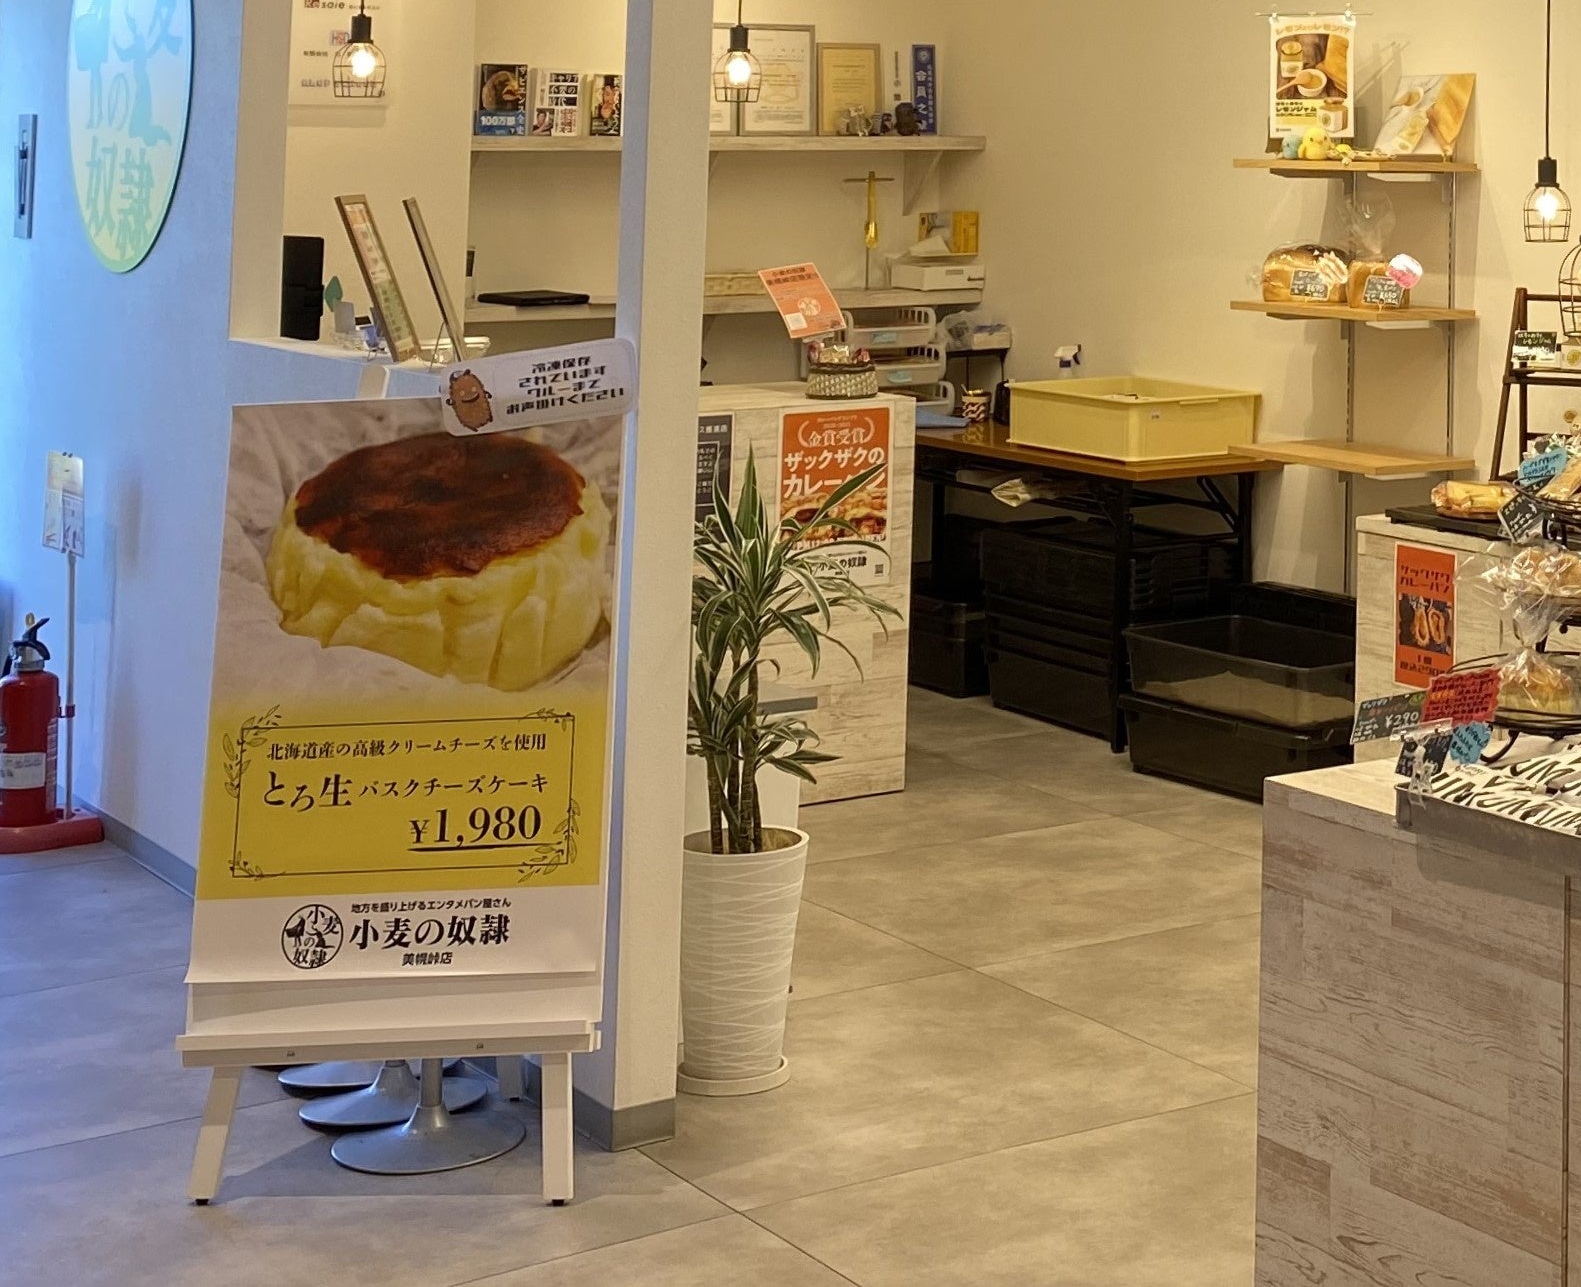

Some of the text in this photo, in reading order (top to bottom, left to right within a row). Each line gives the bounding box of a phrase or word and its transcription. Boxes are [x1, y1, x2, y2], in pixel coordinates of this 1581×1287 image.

[531, 356, 591, 374] 冷凍保存
[518, 366, 607, 388] されています
[527, 378, 602, 398] クルーまで
[506, 388, 625, 415] お声掛けください
[808, 427, 866, 447] 金賞受賞
[784, 446, 886, 473] ザックザクの
[783, 472, 886, 499] カレーン
[1385, 711, 1419, 728] ¥290
[267, 732, 547, 762] 北海道産の高級クリームチーズを使用
[409, 804, 542, 848] ¥1,980
[351, 897, 512, 914] 地方を盛り上げるエンタメパン屋さん
[349, 913, 510, 950] 小麦の奴隷
[401, 952, 453, 966] 美幌峠店
